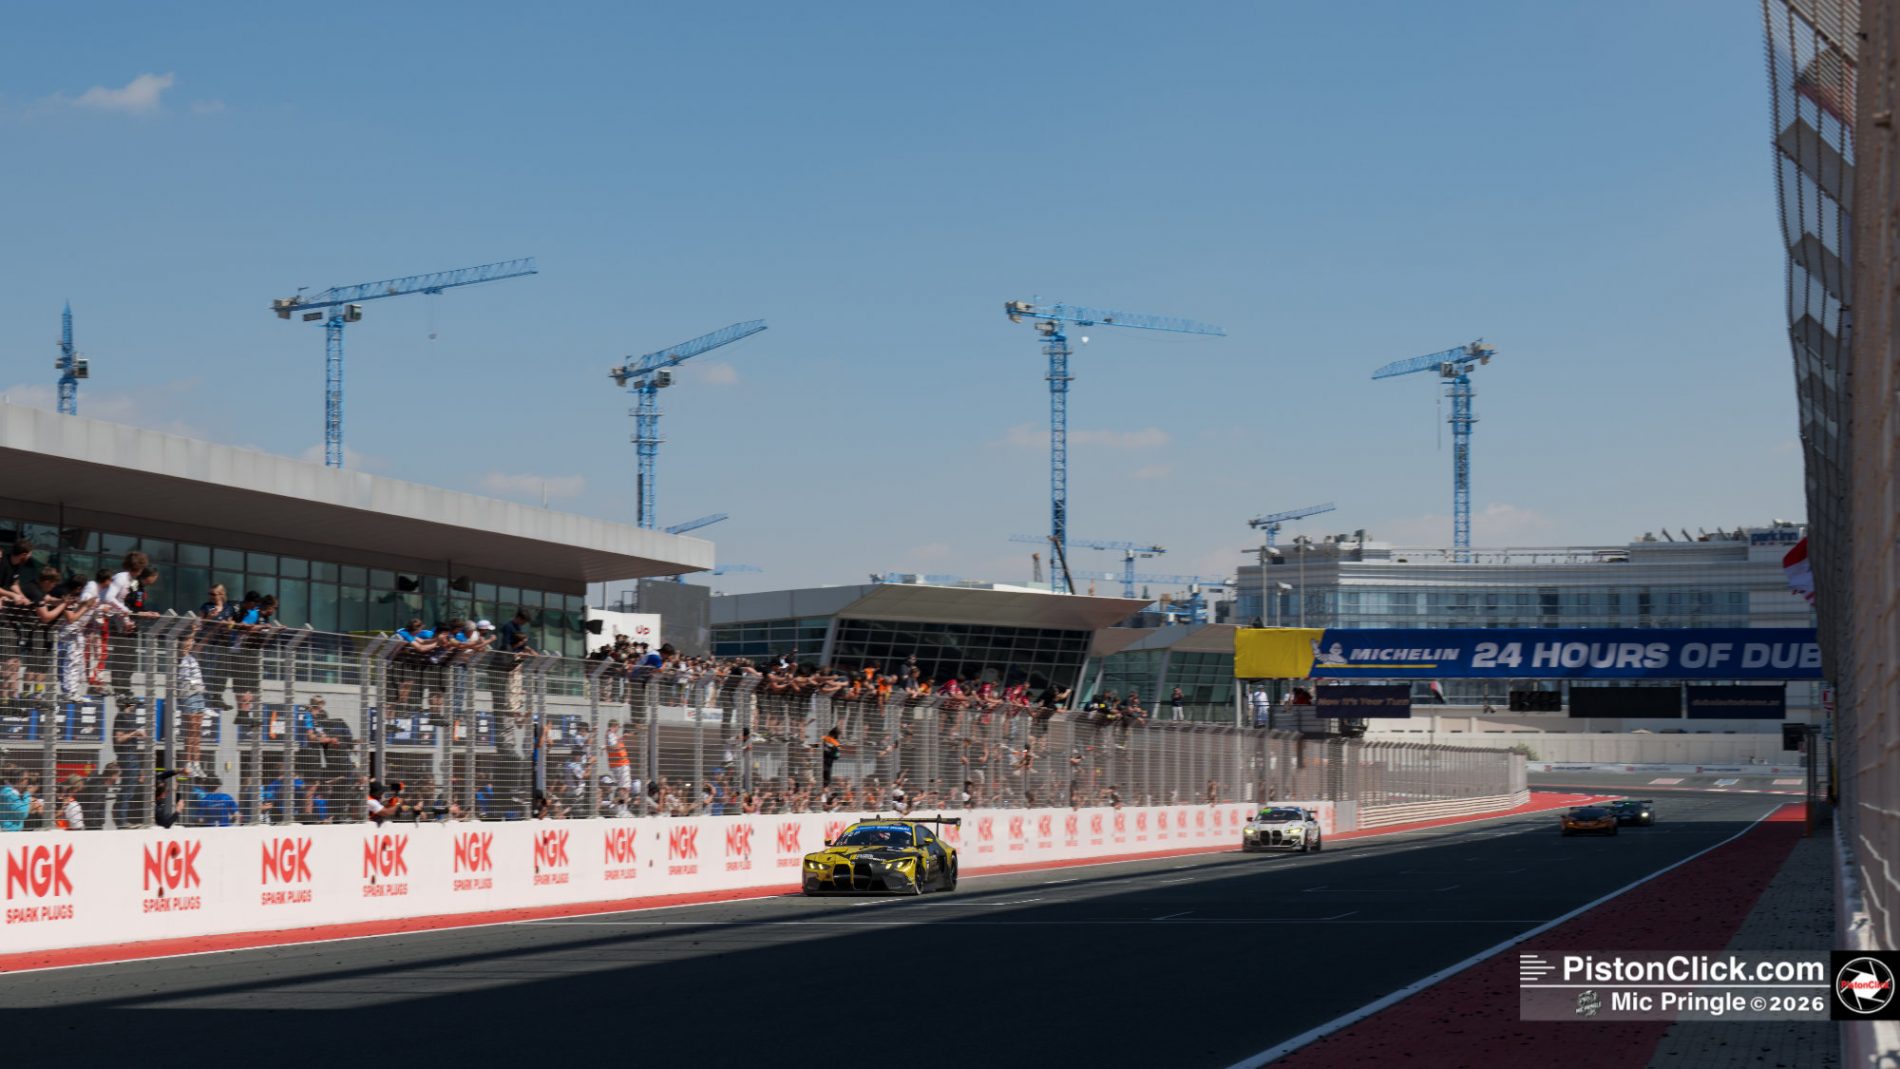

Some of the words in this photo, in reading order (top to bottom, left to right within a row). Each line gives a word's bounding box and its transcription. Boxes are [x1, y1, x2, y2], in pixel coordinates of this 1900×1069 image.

[1350, 648, 1460, 661] MICHELIN
[1472, 642, 1522, 668] 24
[1532, 642, 1669, 669] HOURS
[1680, 642, 1733, 669] OF
[1741, 642, 1822, 669] DUB
[453, 831, 493, 873] NGK
[533, 829, 569, 870] NGK
[604, 827, 636, 865] NGK
[668, 825, 698, 861] NGK
[725, 823, 752, 857] NGK
[776, 821, 801, 853] NGK
[7, 843, 73, 900] NGK
[144, 840, 201, 891] NGK
[261, 837, 312, 885] NGK
[363, 834, 408, 877] NGK
[6, 908, 38, 924] SPARK
[42, 905, 73, 920] PLUGS
[144, 898, 169, 912] SPARK
[173, 896, 200, 910] PLUGS
[262, 891, 285, 905] SPARK
[288, 890, 311, 904] PLUGS
